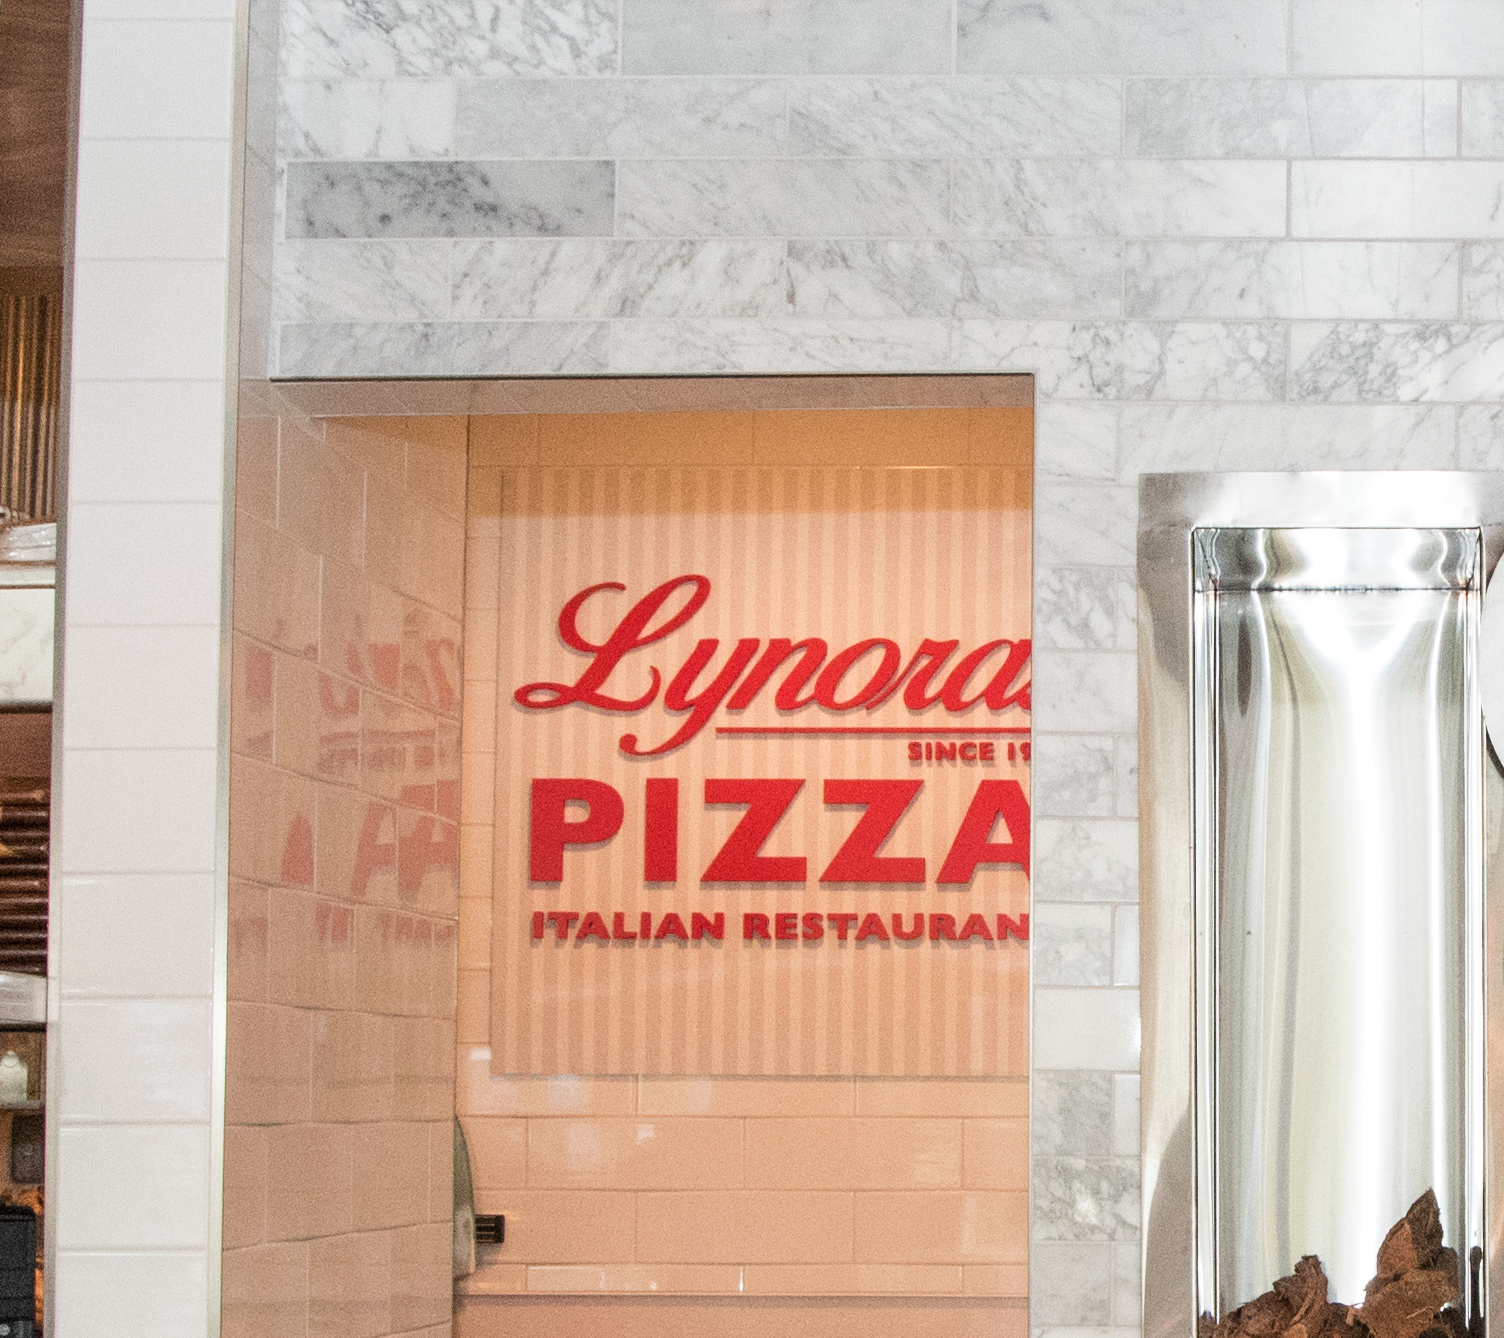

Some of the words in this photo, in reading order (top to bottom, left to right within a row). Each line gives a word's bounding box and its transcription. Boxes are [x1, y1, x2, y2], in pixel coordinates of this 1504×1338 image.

[513, 574, 1031, 756] Lynora
[908, 742, 994, 762] SINCE
[530, 777, 1031, 884] PIZZA
[532, 911, 725, 942] ITALIAN
[743, 912, 1030, 942] RESTAURAN
